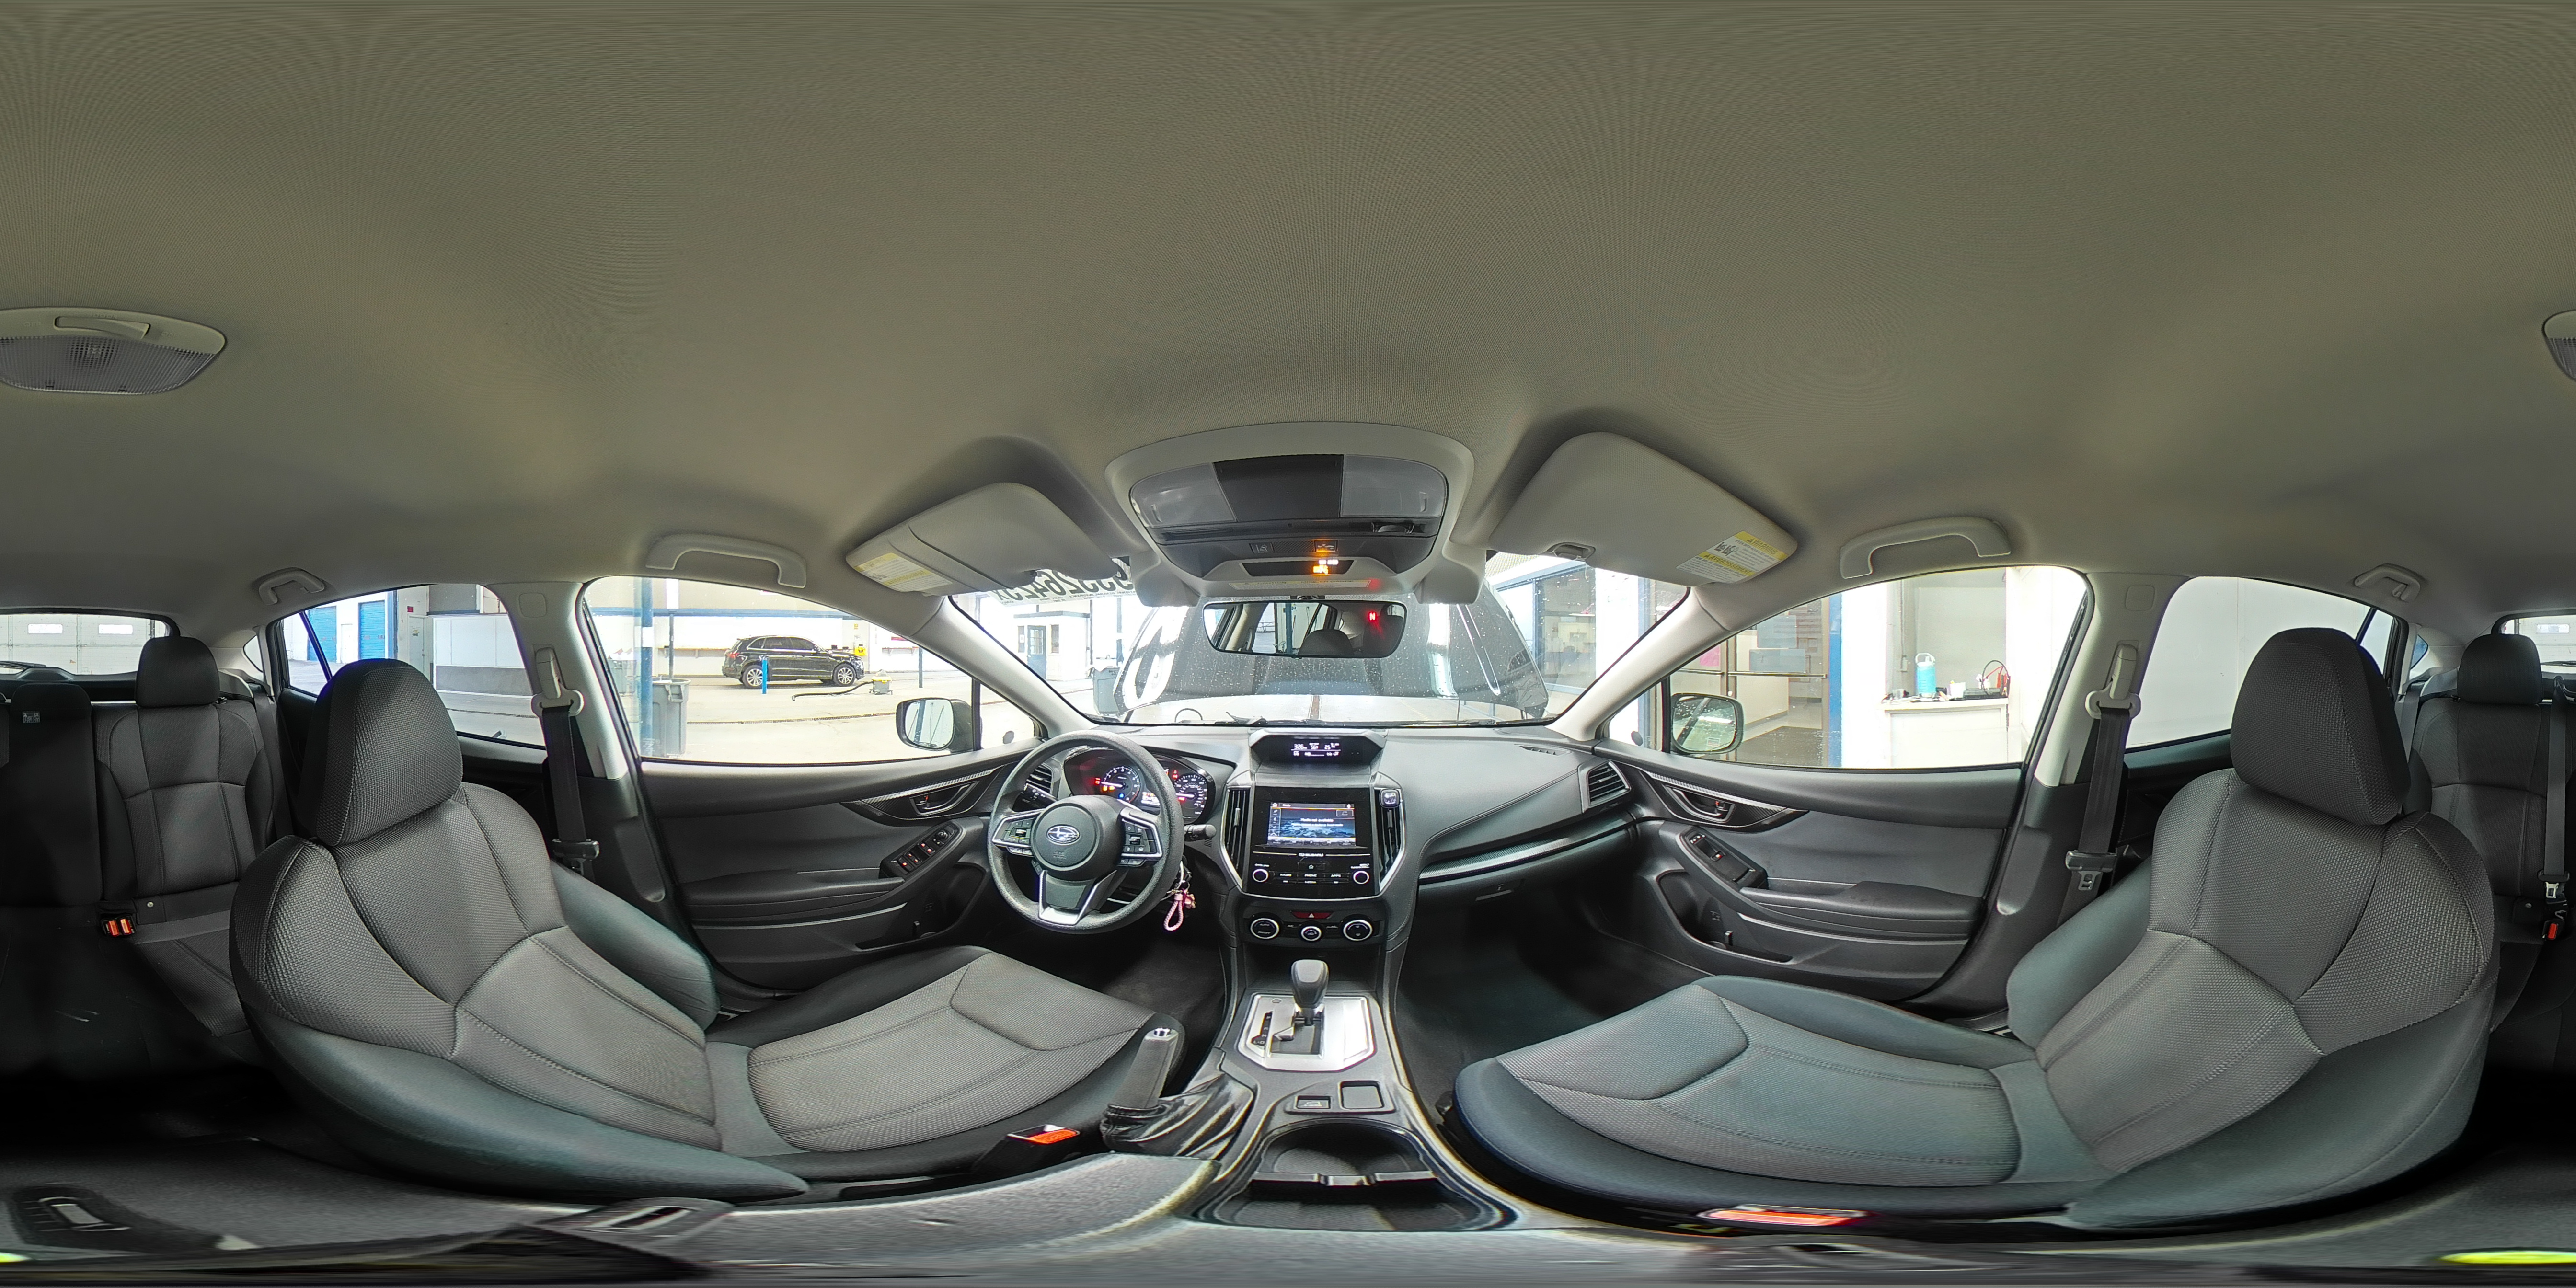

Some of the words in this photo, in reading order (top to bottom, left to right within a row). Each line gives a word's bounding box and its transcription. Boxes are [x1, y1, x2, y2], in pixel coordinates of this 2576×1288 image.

[1752, 539, 1778, 555] WARNING
[1708, 555, 1752, 574] AVERTISSEMENT
[1369, 612, 1376, 621] N
